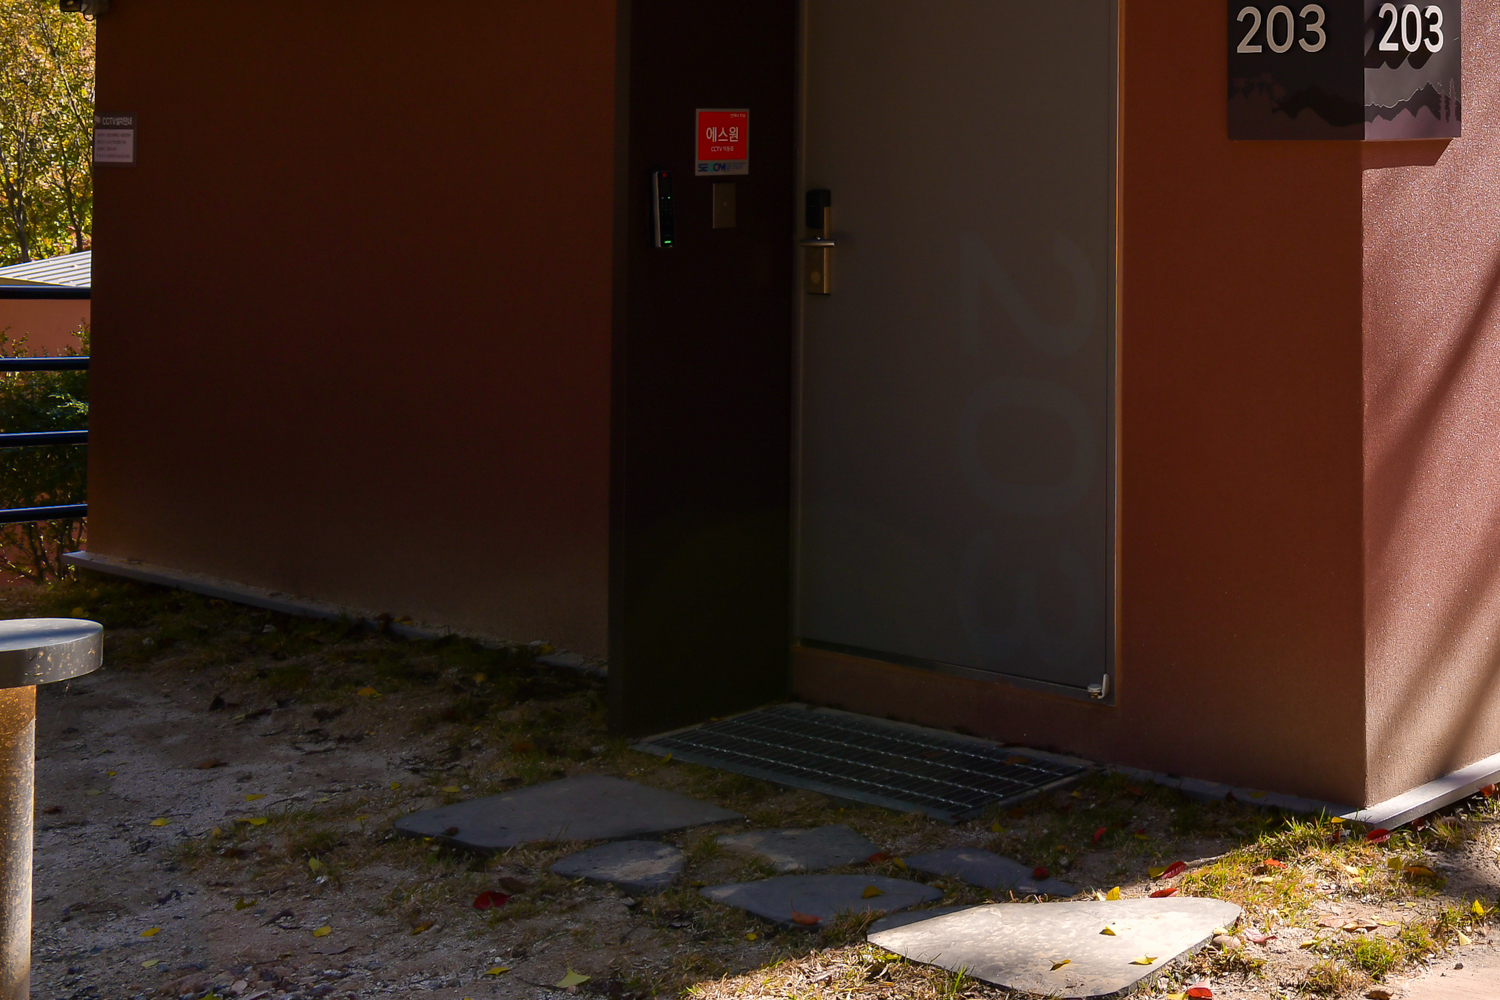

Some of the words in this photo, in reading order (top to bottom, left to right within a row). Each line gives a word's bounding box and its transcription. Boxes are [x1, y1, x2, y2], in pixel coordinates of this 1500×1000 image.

[1236, 4, 1327, 53] 203
[1378, 2, 1444, 53] 203
[706, 126, 738, 142] 에스원
[698, 163, 726, 172] SECOM
[958, 229, 1096, 669] 203
